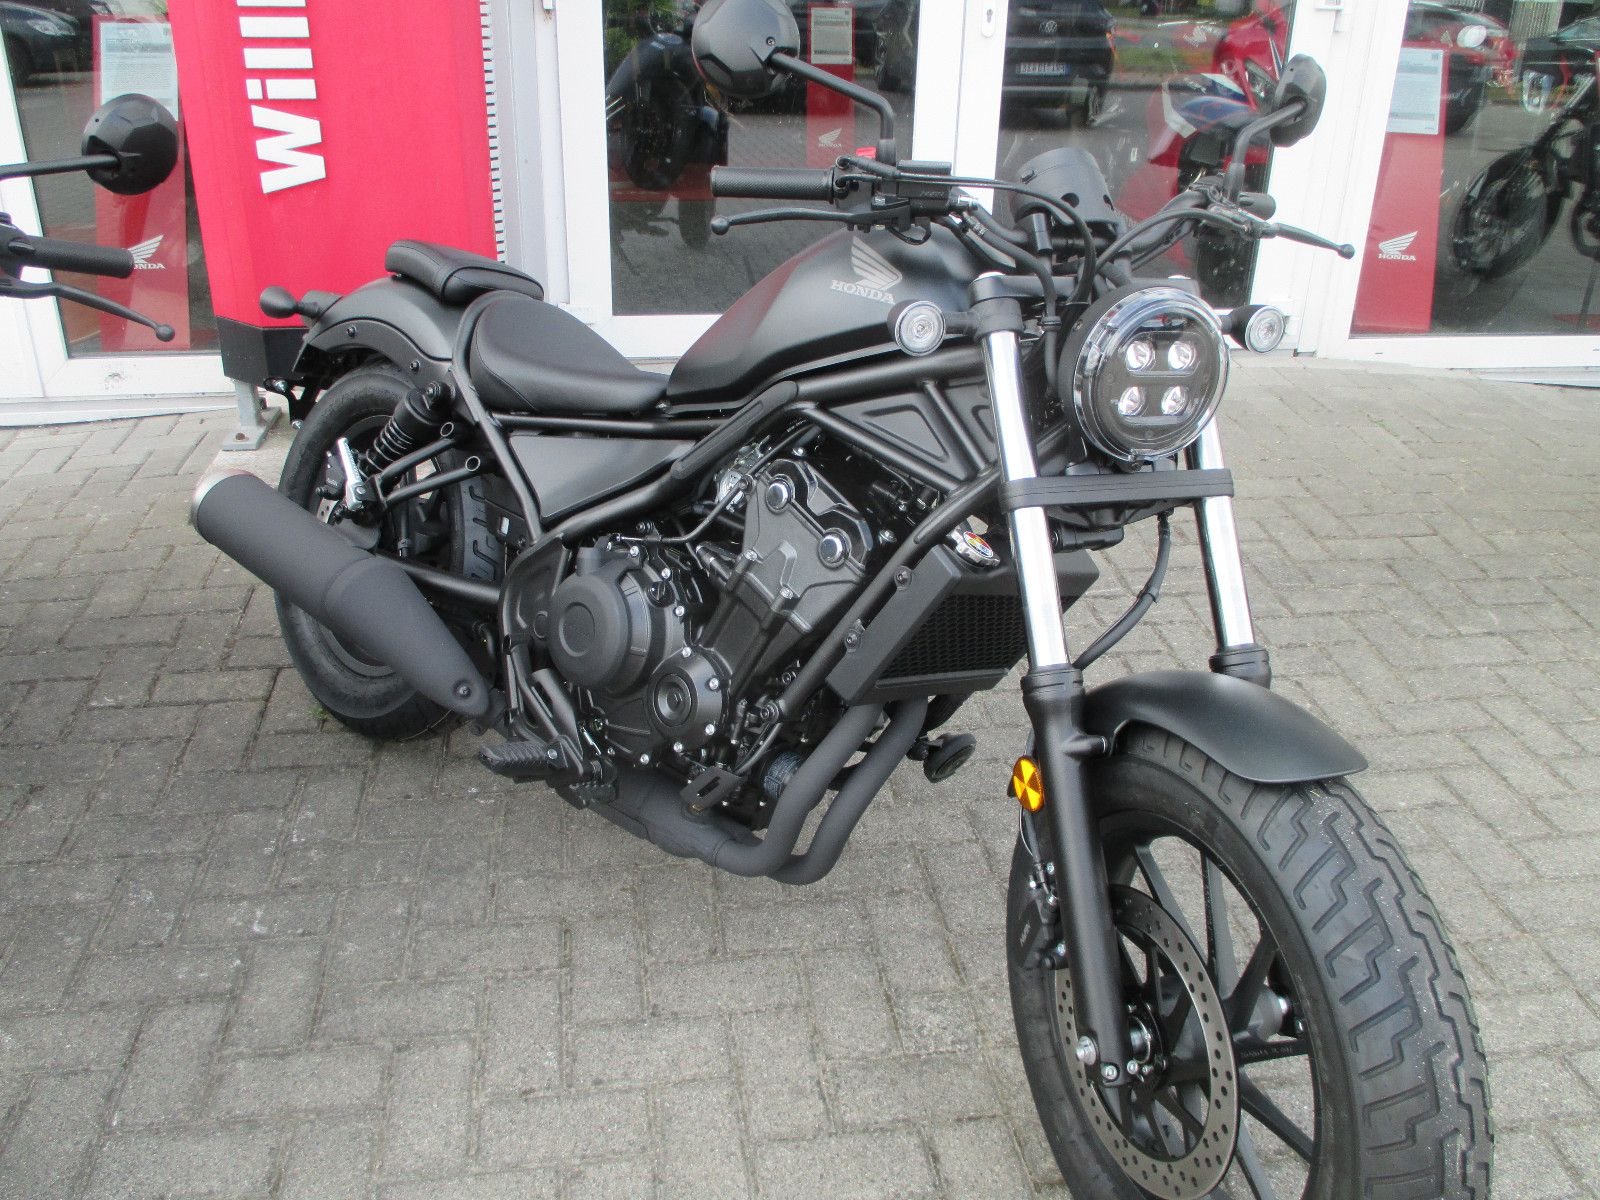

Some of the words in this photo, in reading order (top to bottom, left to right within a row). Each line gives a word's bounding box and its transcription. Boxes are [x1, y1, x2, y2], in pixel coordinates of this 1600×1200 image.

[1378, 253, 1417, 261] HONDA
[133, 262, 166, 270] ONDA
[830, 279, 896, 305] HONDA
